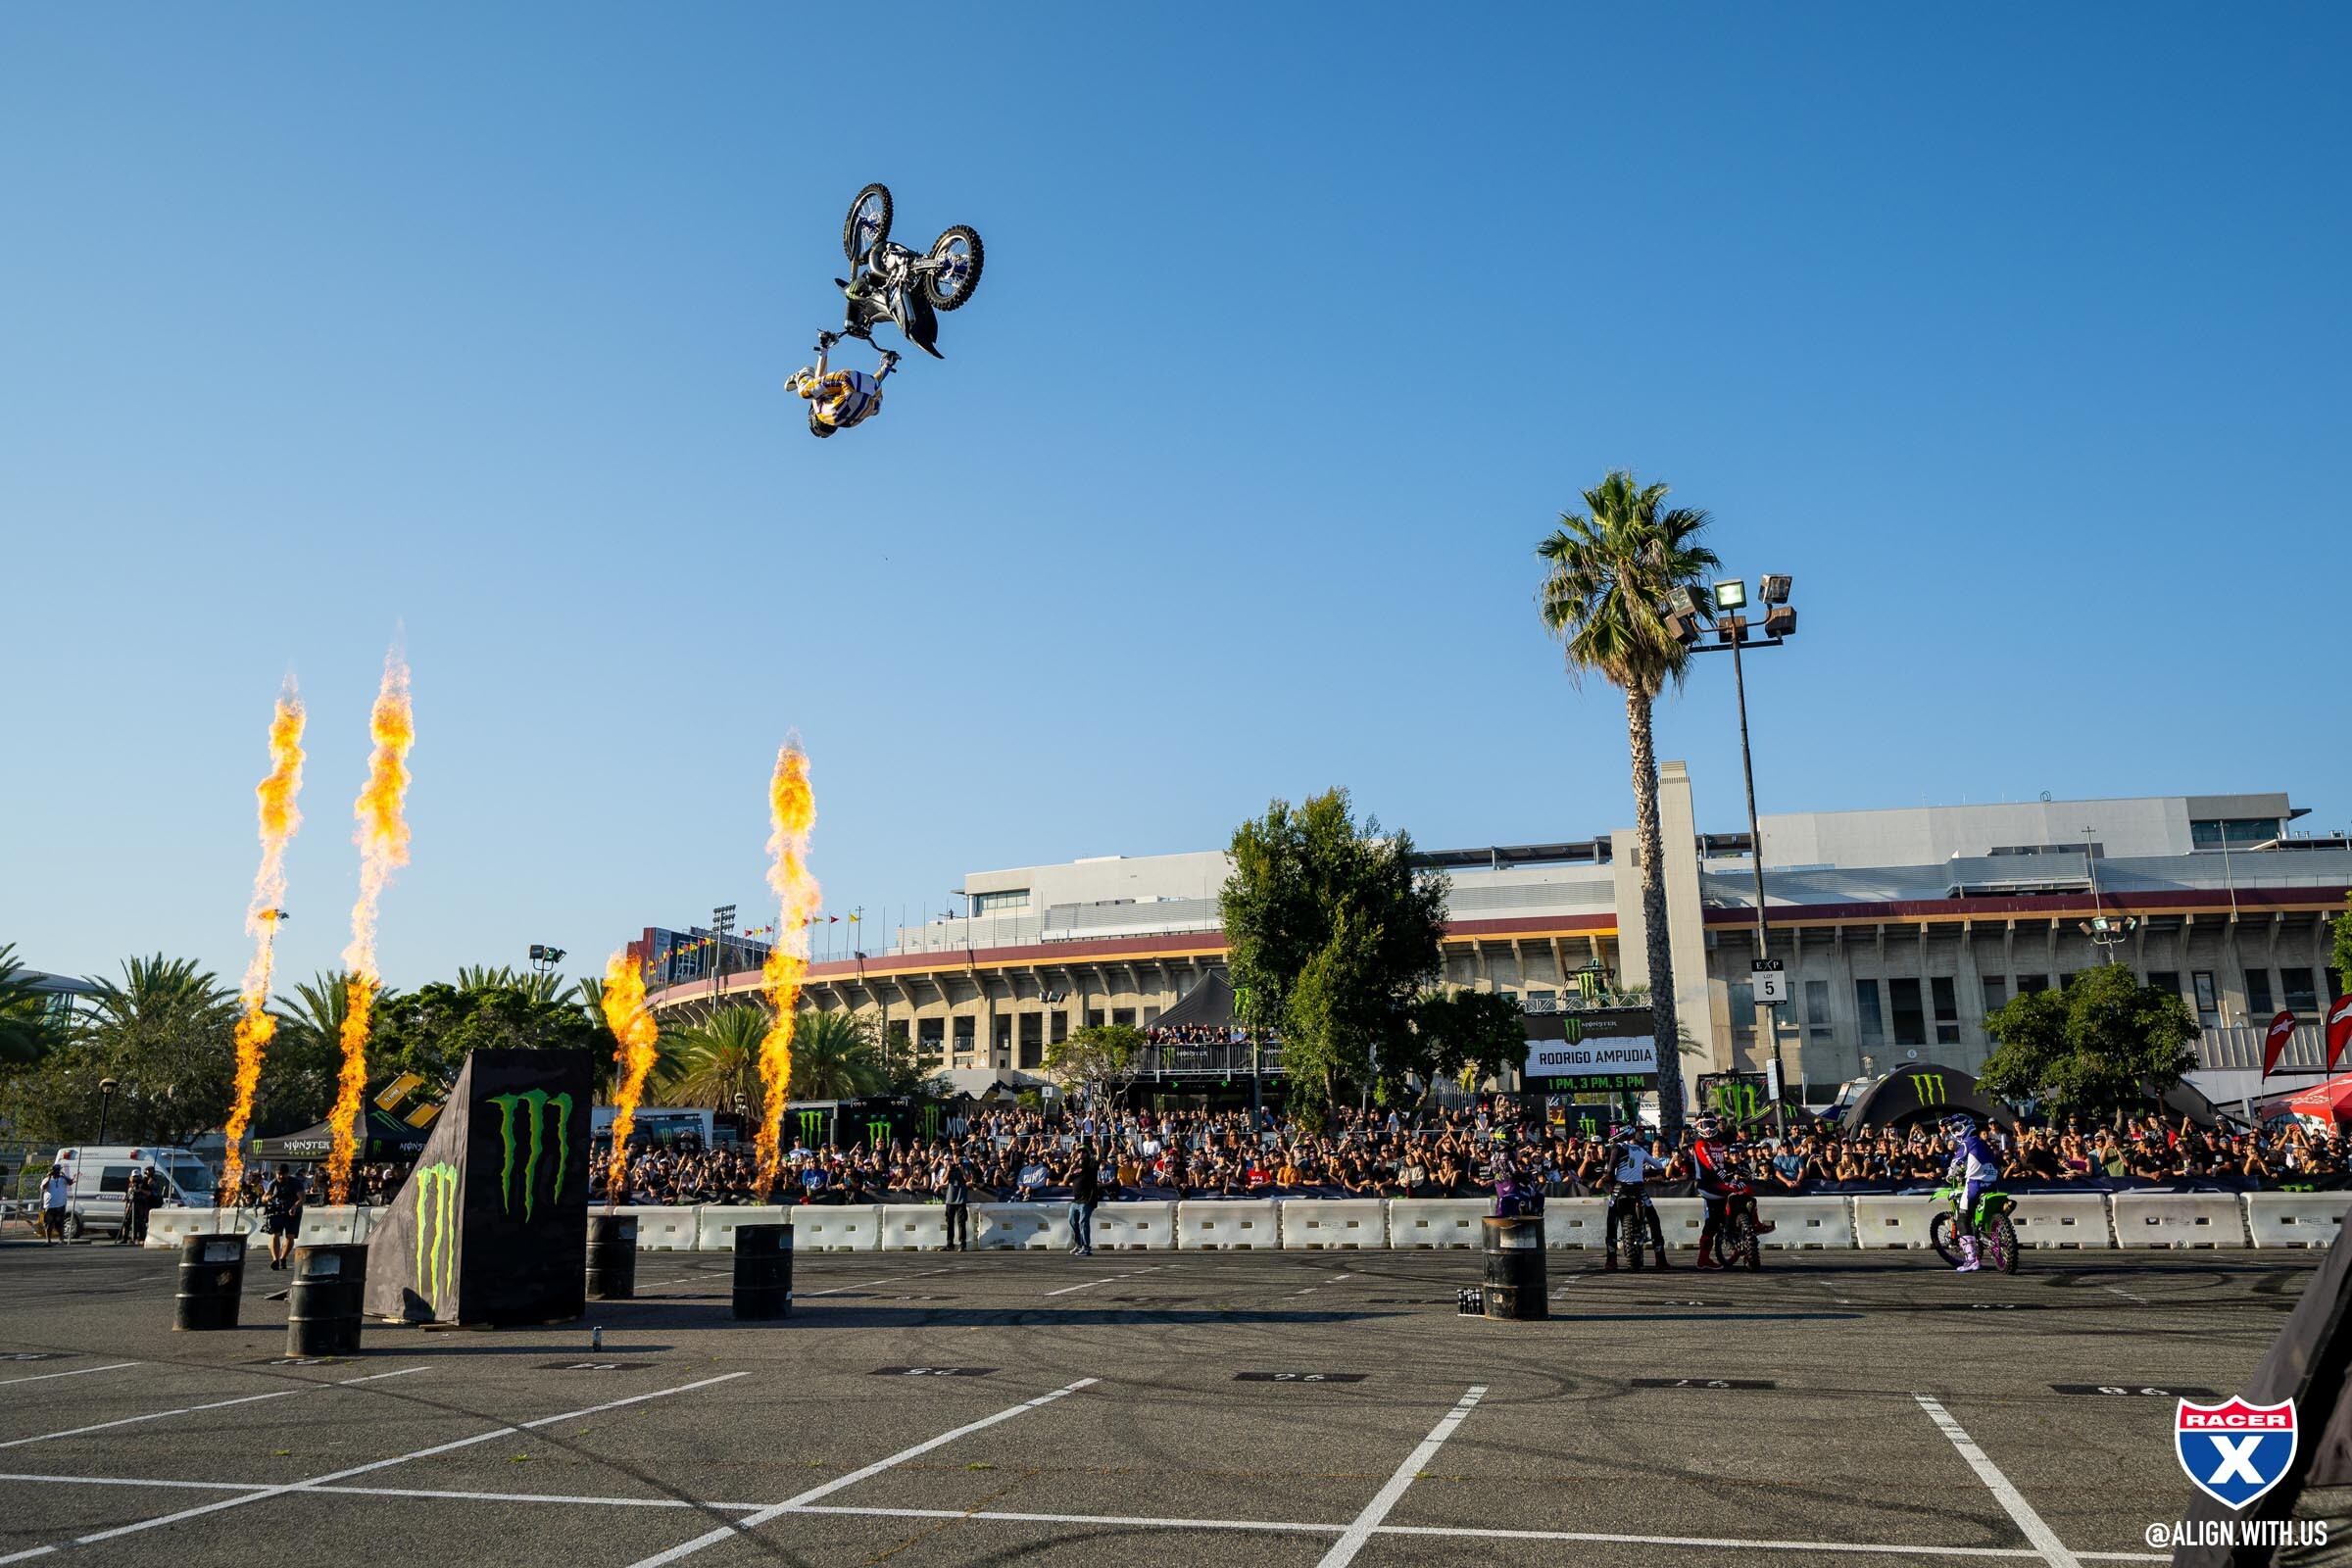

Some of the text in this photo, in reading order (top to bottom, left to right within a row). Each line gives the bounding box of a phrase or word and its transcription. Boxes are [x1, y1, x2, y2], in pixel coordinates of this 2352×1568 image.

[1756, 959, 1780, 970] EXP
[1765, 981, 1775, 995] 5
[1539, 1048, 1653, 1066] RODRIGO AMPUDIA
[1548, 1076, 1645, 1090] 1 PM, 3 PM, 5 PM
[283, 1140, 331, 1151] MONSTER
